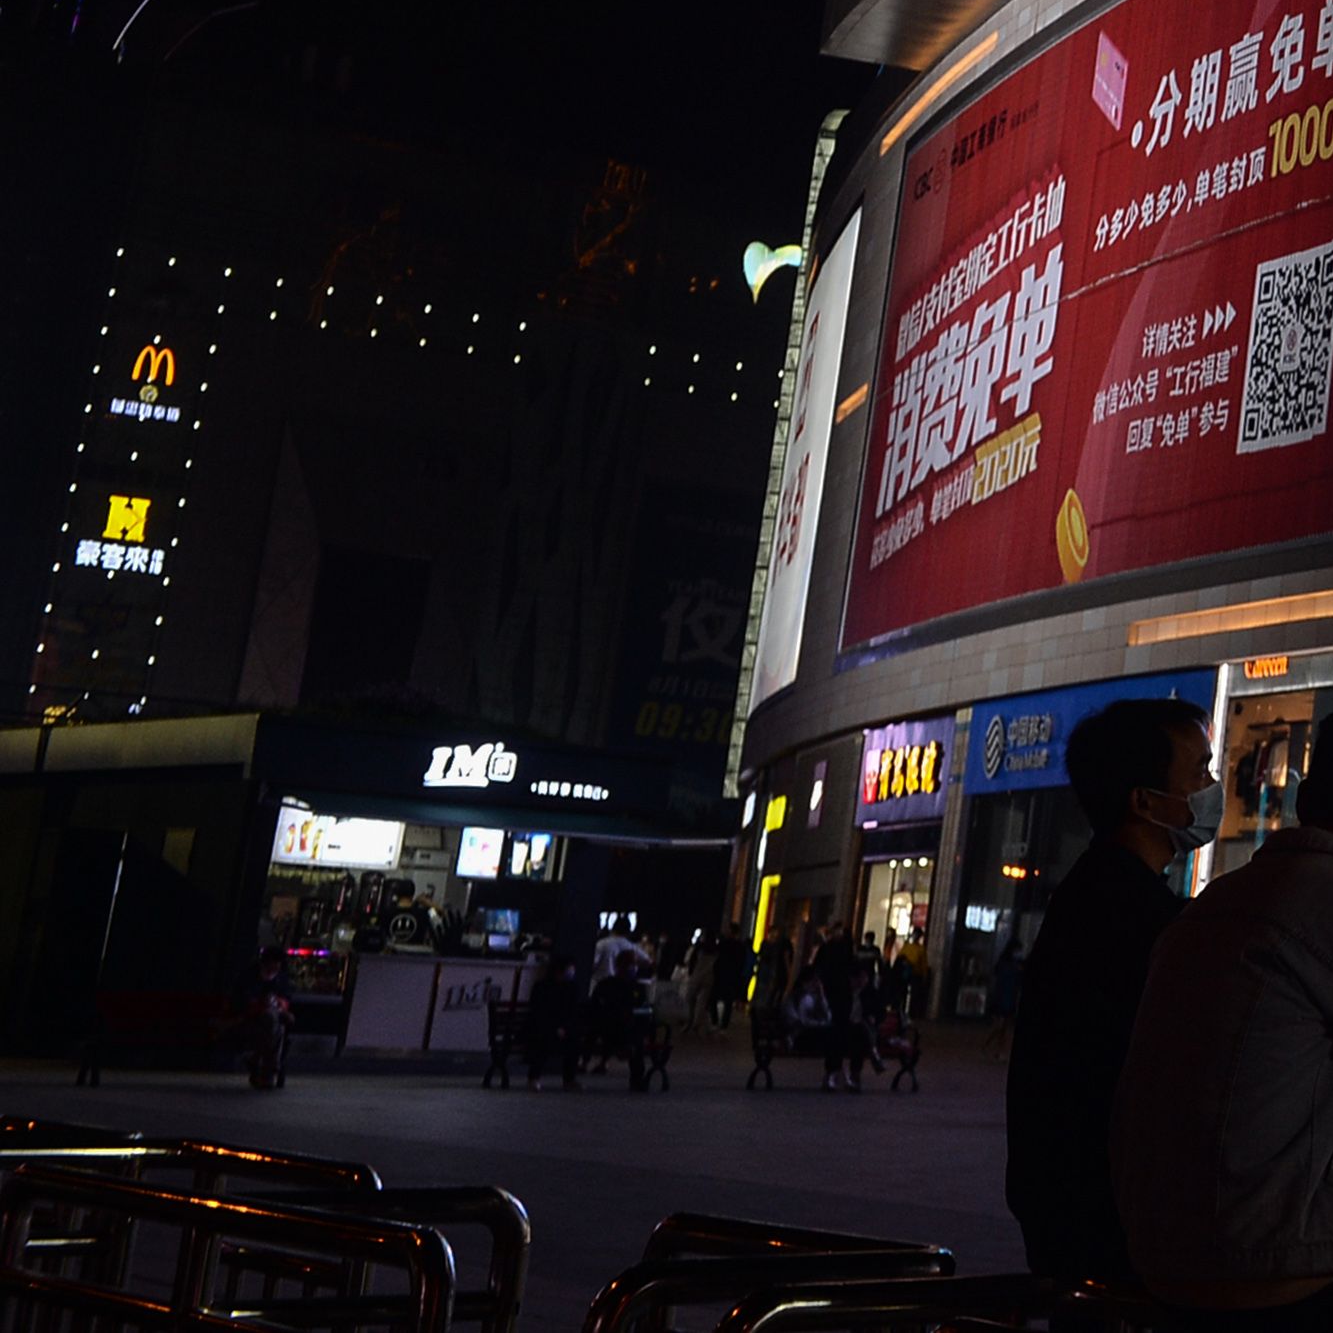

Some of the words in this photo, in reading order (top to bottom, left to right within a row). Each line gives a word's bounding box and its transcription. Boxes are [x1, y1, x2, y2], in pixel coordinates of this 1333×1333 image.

[1141, 314, 1198, 358] 详情关注
[876, 242, 1064, 519] 消费免单
[971, 424, 1042, 506] 2020元
